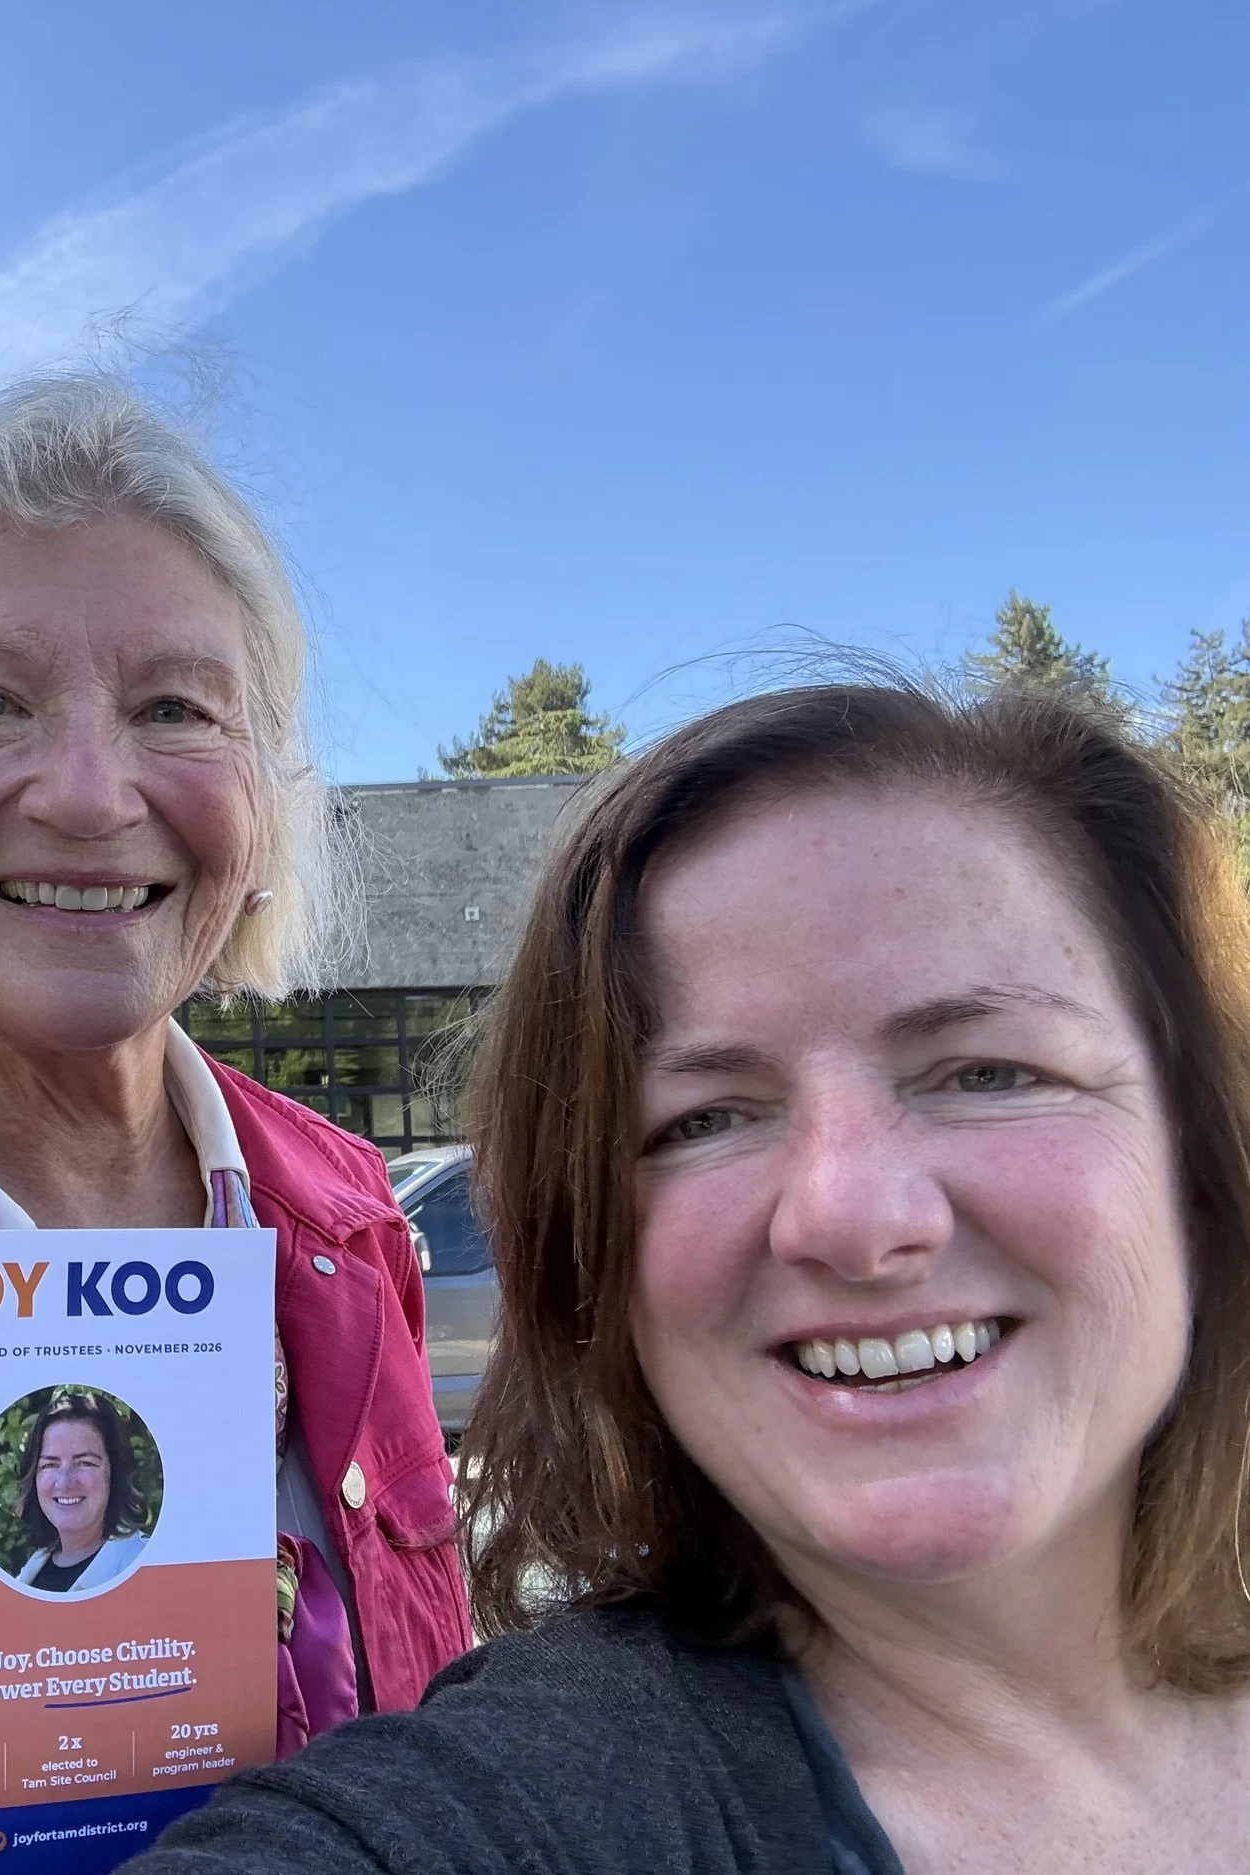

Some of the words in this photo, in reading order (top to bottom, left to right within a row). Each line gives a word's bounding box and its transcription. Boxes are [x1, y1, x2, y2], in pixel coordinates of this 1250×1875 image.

[67, 1260, 215, 1317] KOO
[12, 1346, 31, 1357] OF
[34, 1345, 103, 1357] TRUSTEES
[115, 1343, 189, 1355] NOVEMBER
[193, 1342, 222, 1353] 2026
[35, 1646, 113, 1669] Choose
[116, 1637, 196, 1662] Civility.
[45, 1677, 107, 1697] Every
[109, 1667, 197, 1692] Student.
[171, 1723, 191, 1739] 20
[193, 1723, 218, 1740] yrs
[165, 1746, 213, 1760] engineer
[215, 1743, 223, 1753] &
[41, 1758, 83, 1772] elected
[86, 1758, 98, 1768] to
[152, 1762, 199, 1777] program
[202, 1757, 236, 1769] leader
[21, 1778, 47, 1789] Tam
[50, 1774, 72, 1787] Site
[74, 1769, 117, 1784] Council
[12, 1820, 148, 1848] joyfortamdistrict.org
